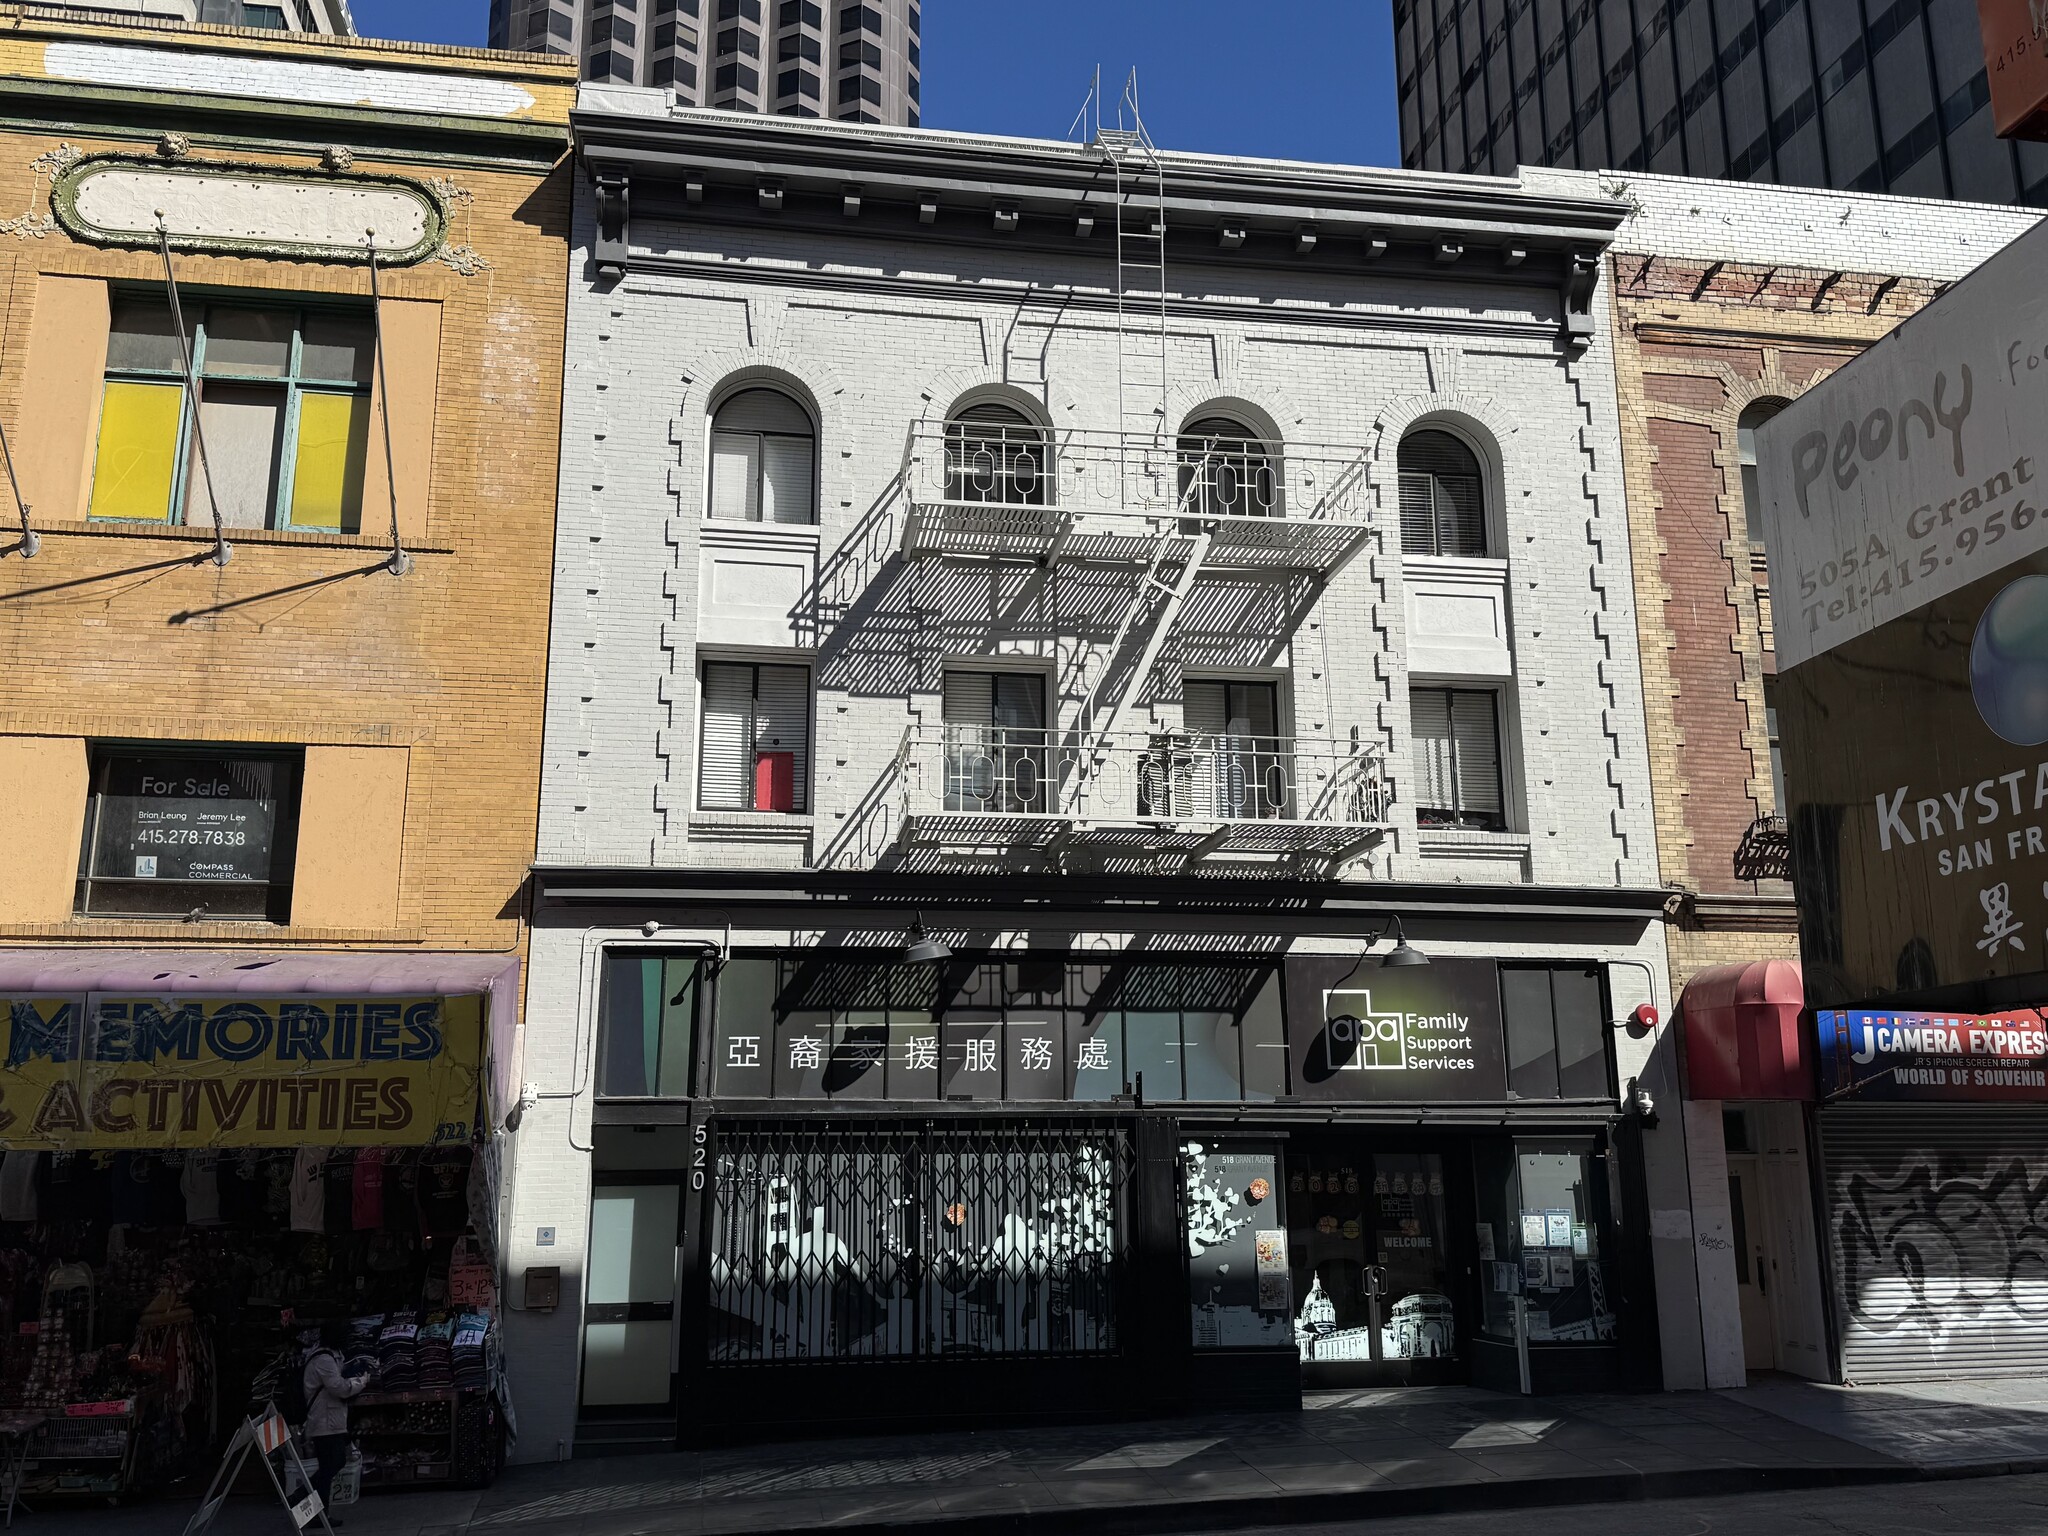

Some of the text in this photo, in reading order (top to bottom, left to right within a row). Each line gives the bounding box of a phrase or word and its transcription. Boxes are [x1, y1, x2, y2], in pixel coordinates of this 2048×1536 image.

[1791, 363, 1974, 519] Peony
[1800, 455, 2035, 600] 505A Grant
[141, 776, 231, 796] For Sale
[138, 811, 187, 821] Brian Leung
[197, 812, 247, 822] Jeremy Lee
[137, 829, 246, 846] 415.278.7838
[1937, 837, 1994, 876] SAN
[188, 871, 253, 880] COMMERCIAL
[189, 863, 234, 871] COMPASS
[1405, 1012, 1469, 1032] Family
[9, 1003, 442, 1063] MEMORIES
[1406, 1035, 1472, 1053] Support
[1408, 1056, 1475, 1071] Services
[1966, 1057, 1999, 1067] SCREEN
[2000, 1058, 2030, 1068] REPAIR
[1893, 1068, 2046, 1087] WORLD OF SOUVENIR
[34, 1076, 413, 1132] ACTIVITIES
[692, 1124, 707, 1190] 520
[1222, 1155, 1235, 1164] 518
[1236, 1155, 1254, 1164] GRANT
[1383, 1236, 1432, 1248] WELCOME
